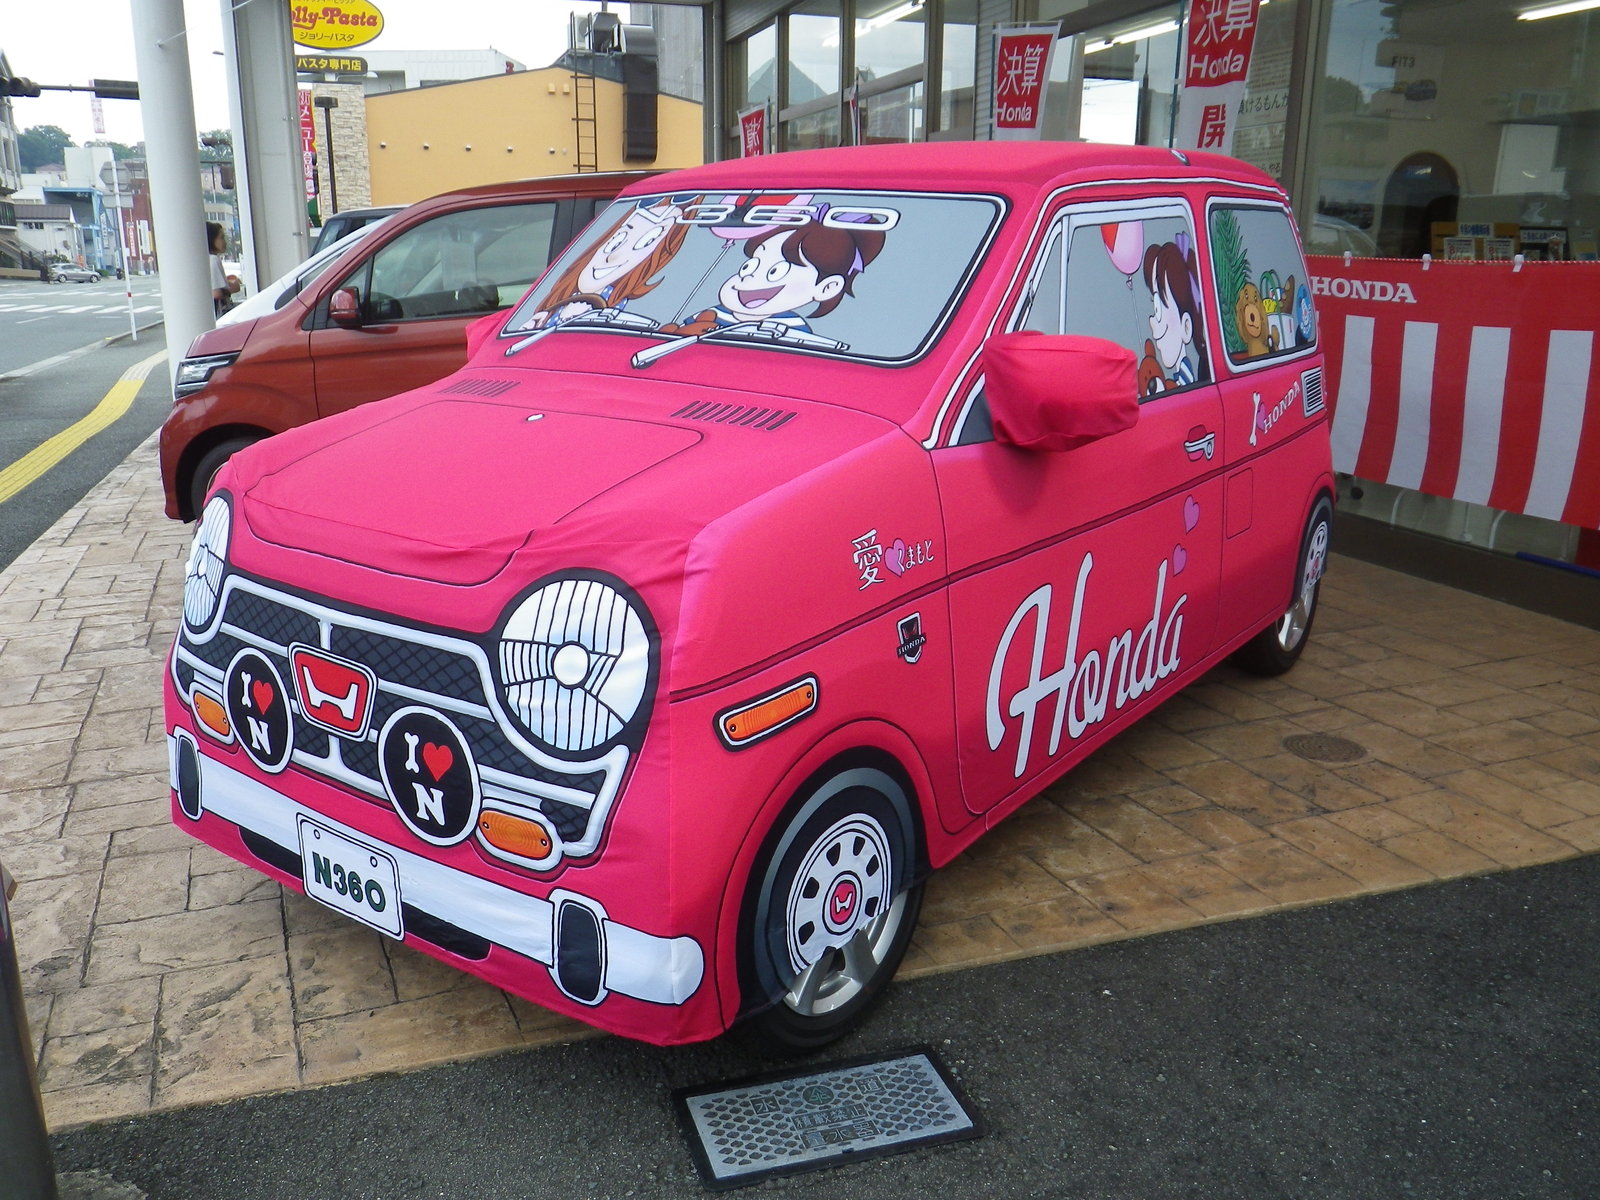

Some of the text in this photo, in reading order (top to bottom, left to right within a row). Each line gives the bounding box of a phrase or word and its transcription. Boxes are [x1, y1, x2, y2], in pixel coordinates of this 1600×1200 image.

[300, 31, 355, 42] ジョリーパスタ
[1193, 0, 1254, 48] 決算
[997, 44, 1045, 96] 決算
[1189, 48, 1245, 79] Honda
[996, 101, 1032, 122] Honda
[1197, 103, 1226, 149] 開
[1310, 275, 1418, 304] HONDA
[1263, 380, 1301, 434] HONDA
[851, 529, 935, 591] 愛 くまもと
[898, 636, 926, 656] HONDA
[985, 551, 1188, 779] Honda
[312, 850, 386, 914] N360
